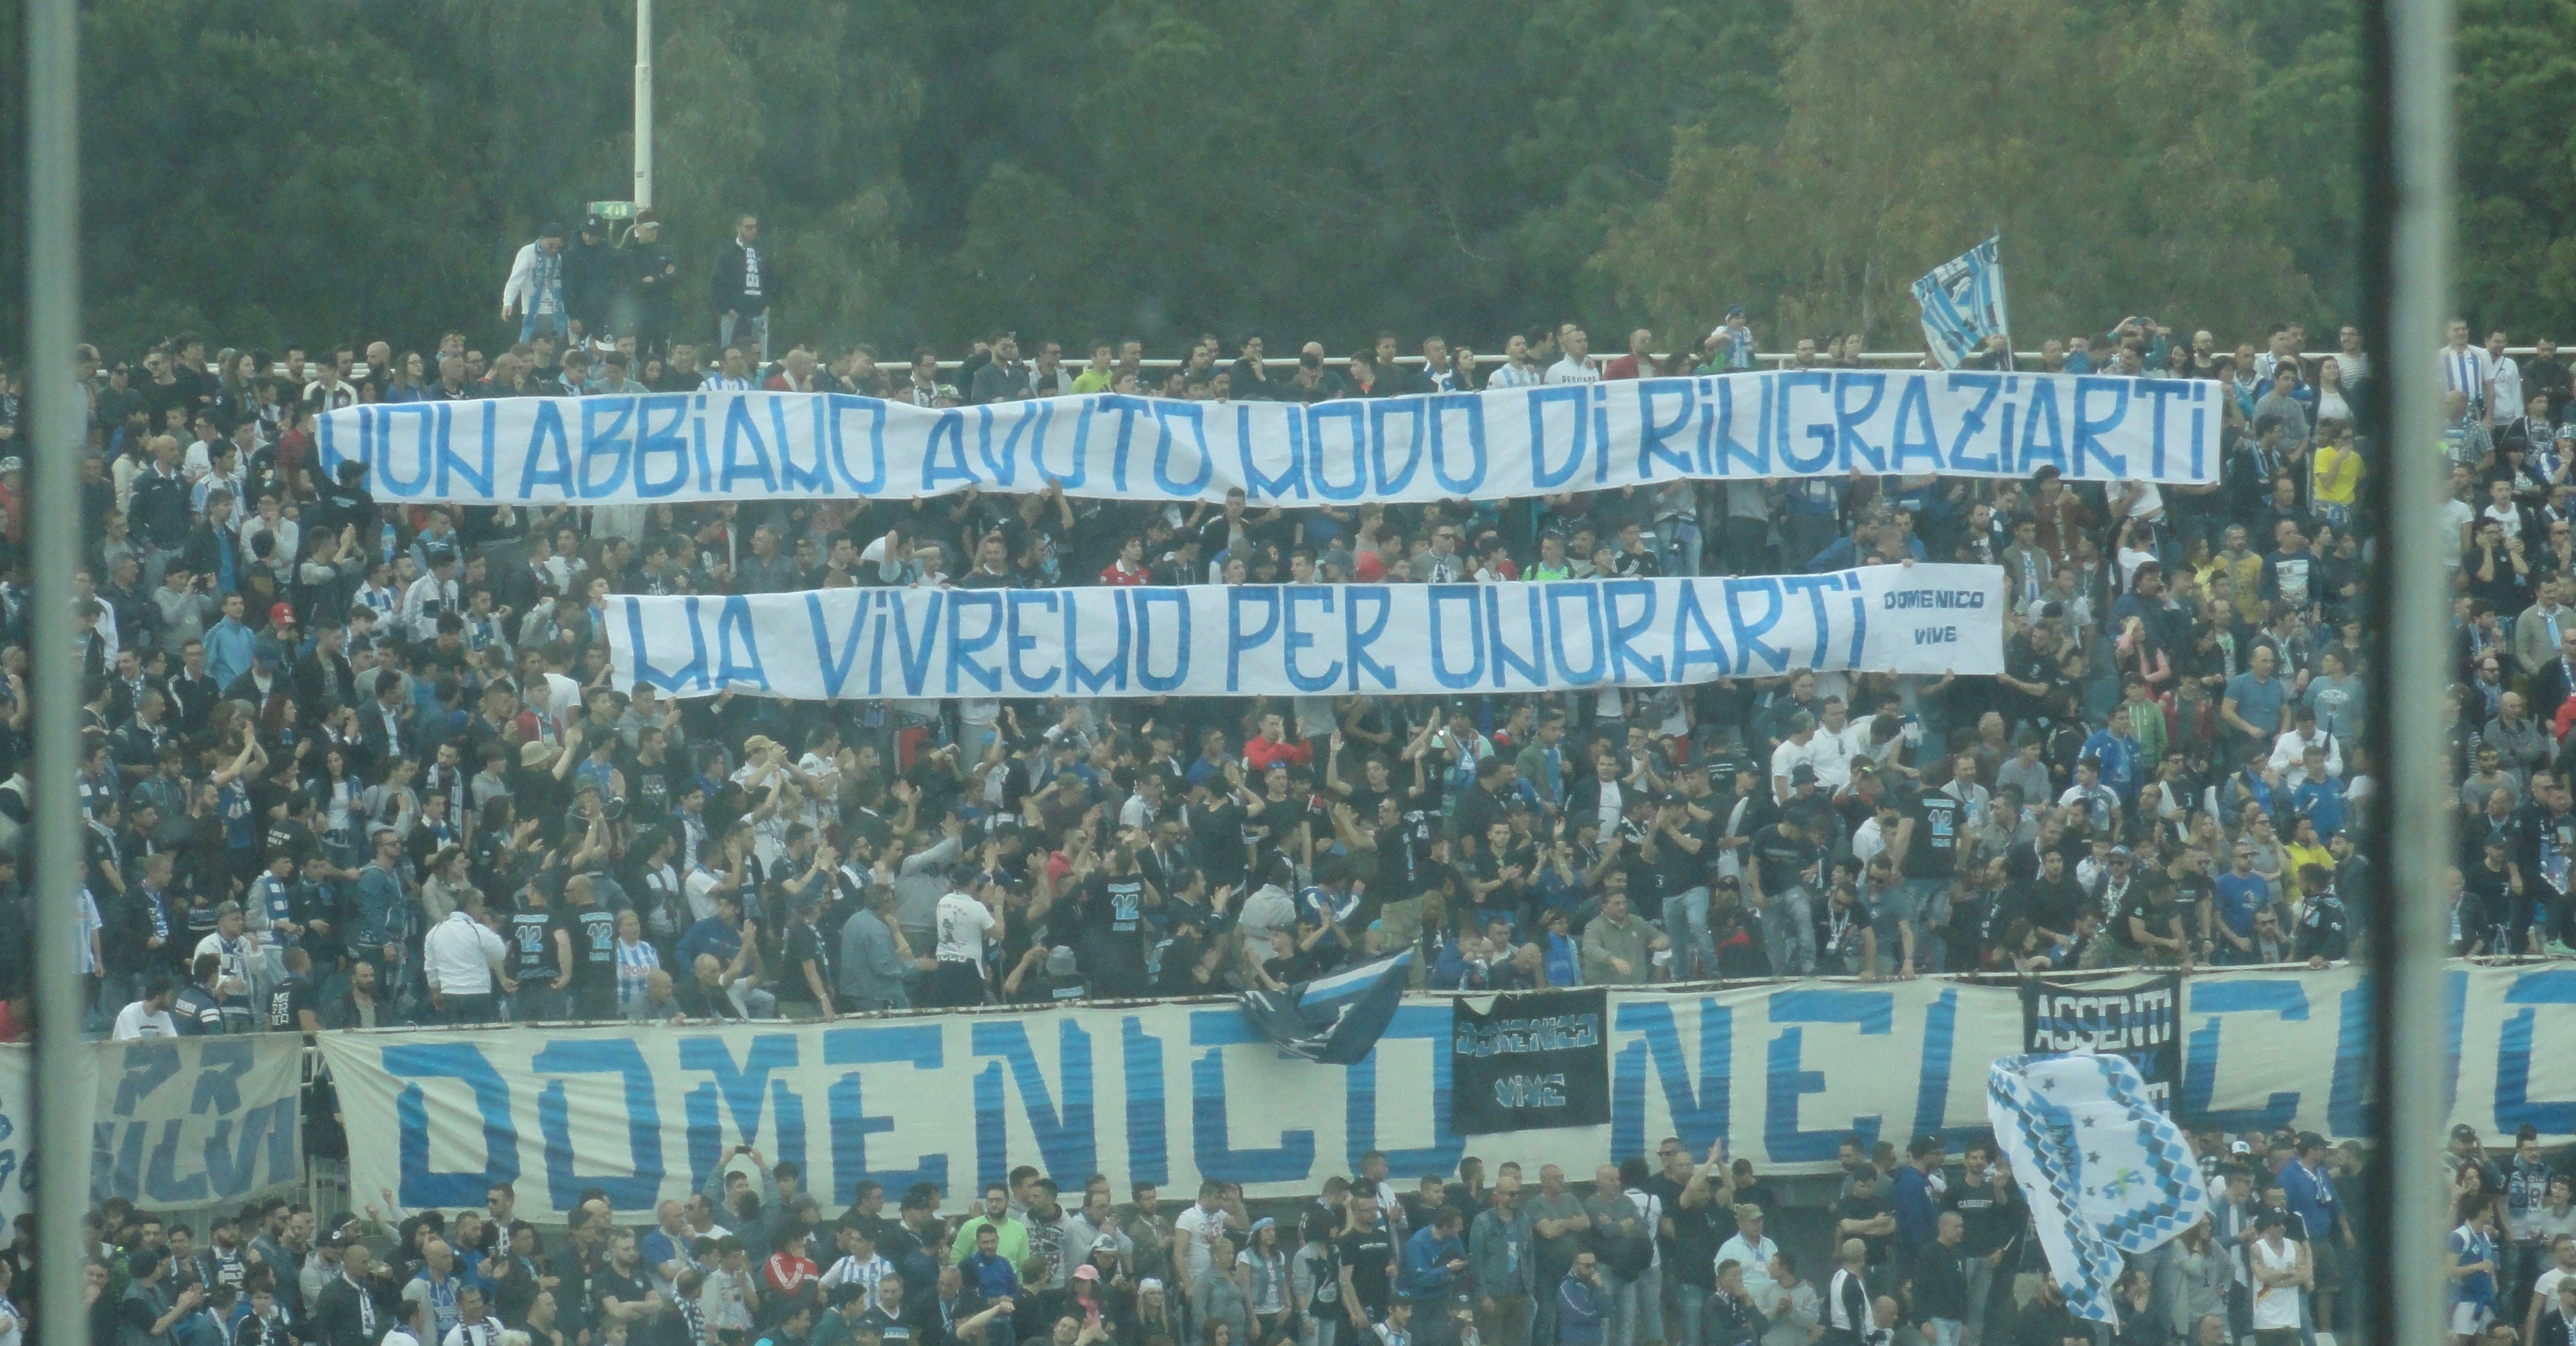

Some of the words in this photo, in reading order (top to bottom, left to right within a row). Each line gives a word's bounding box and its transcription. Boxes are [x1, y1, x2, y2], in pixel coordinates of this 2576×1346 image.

[921, 394, 1213, 494] AVUTO
[1237, 394, 1488, 500] MODO
[624, 595, 769, 692] MA
[1225, 584, 1398, 692] PER
[1928, 809, 1953, 836] 12
[1111, 894, 1140, 920] 12
[515, 926, 544, 952] 12
[587, 923, 613, 949] 12
[382, 1004, 1467, 1211] DOMENICO
[1610, 988, 1995, 1164] NEL
